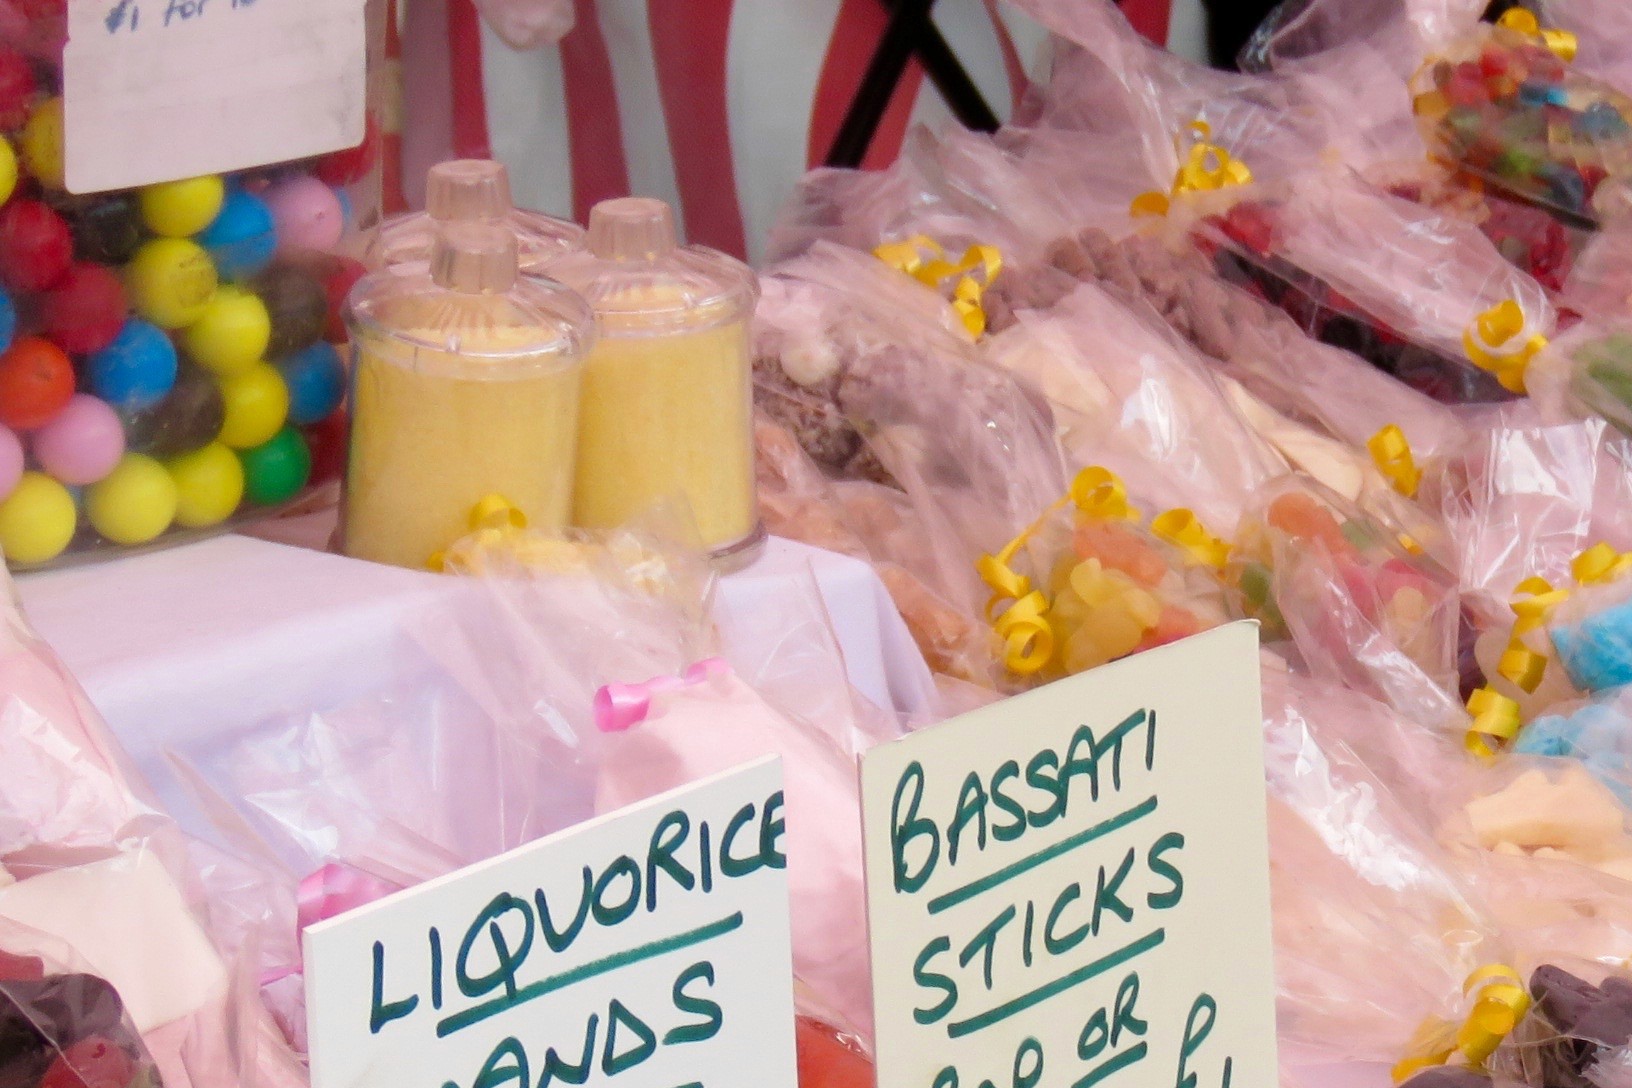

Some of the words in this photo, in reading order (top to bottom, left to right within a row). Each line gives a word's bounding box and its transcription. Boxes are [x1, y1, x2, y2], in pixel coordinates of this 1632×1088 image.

[891, 707, 1157, 894] BASSATI
[370, 790, 787, 1034] LIQUORICE
[913, 832, 1184, 1025] STICKS
